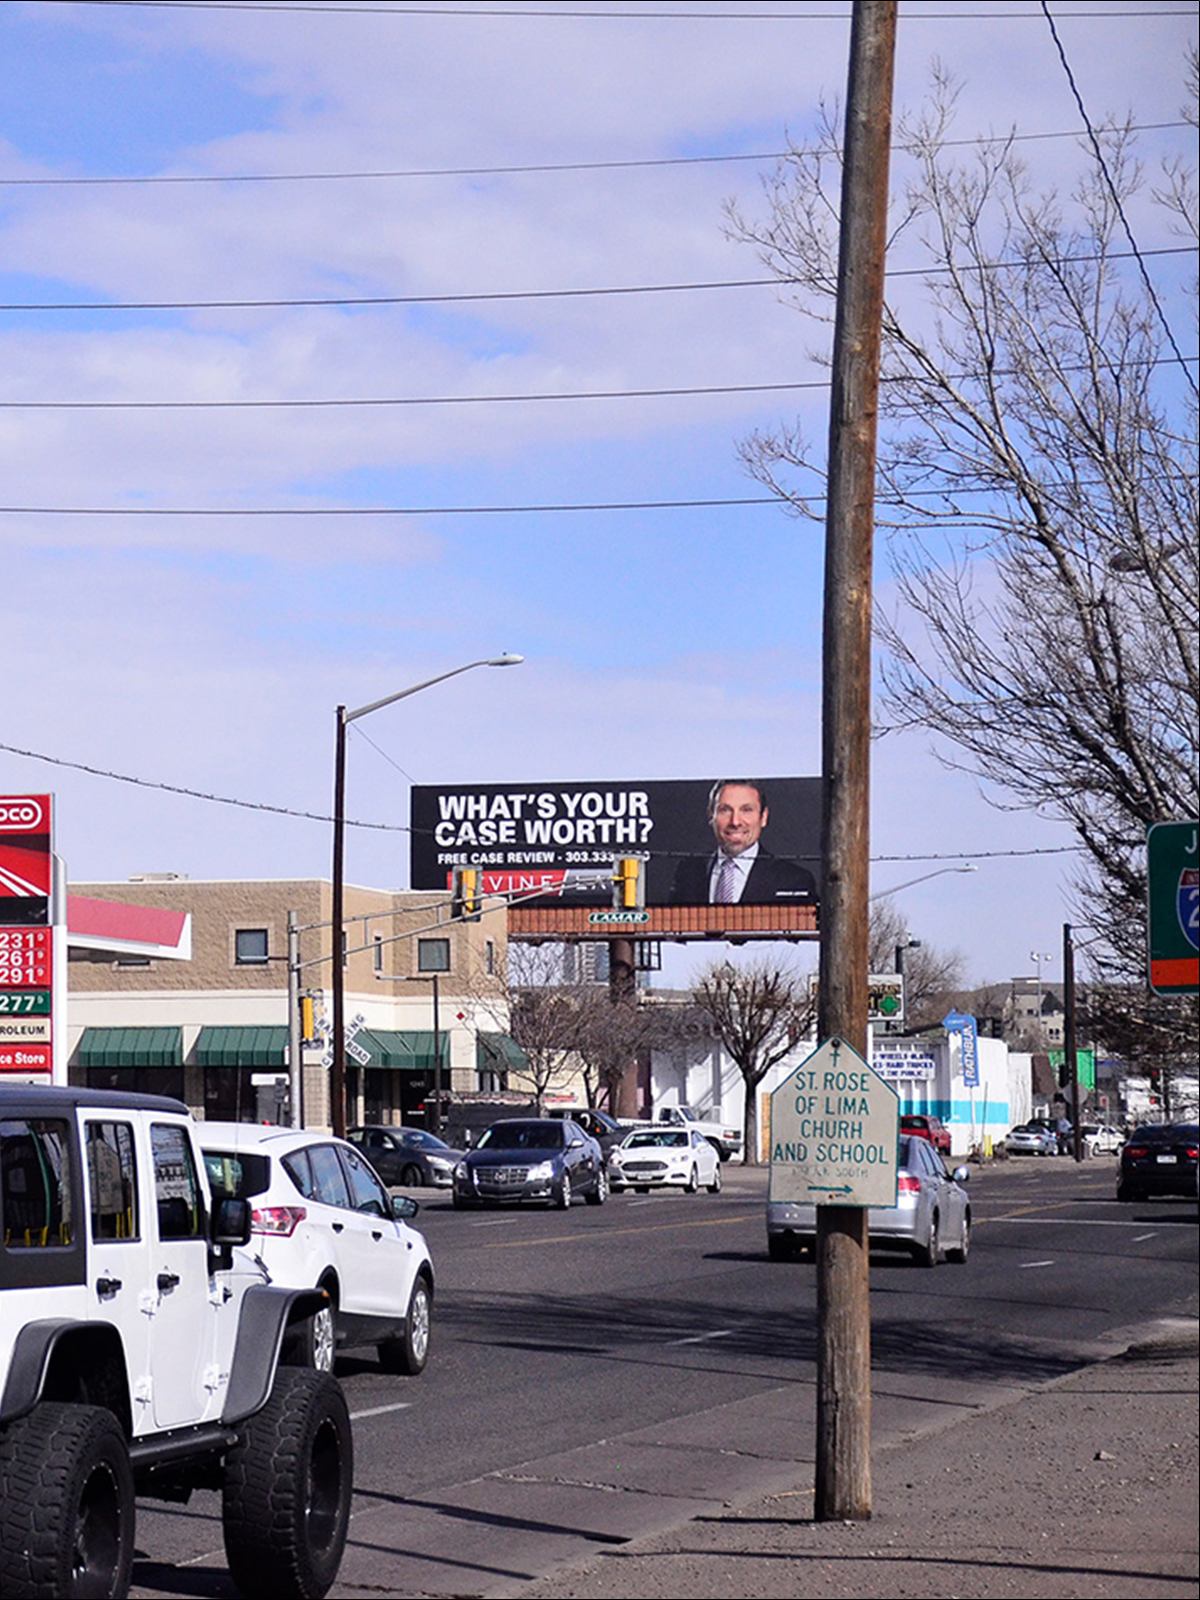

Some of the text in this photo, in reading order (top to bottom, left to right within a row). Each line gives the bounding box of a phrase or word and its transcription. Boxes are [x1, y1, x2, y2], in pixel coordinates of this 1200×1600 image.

[438, 792, 649, 820] WHAT'S YOUR
[435, 819, 654, 847] CASE WORTH?
[437, 854, 468, 865] FREE
[470, 853, 504, 864] CASE
[507, 851, 555, 863] REVIEW
[593, 913, 642, 923] LAMAR
[15, 1051, 45, 1064] Store
[346, 1041, 369, 1063] ROAD
[794, 1071, 870, 1092] ST. ROSE
[795, 1096, 870, 1116] OF LIMA
[800, 1119, 863, 1139] CHURH
[773, 1143, 889, 1165] AND SCHOOL
